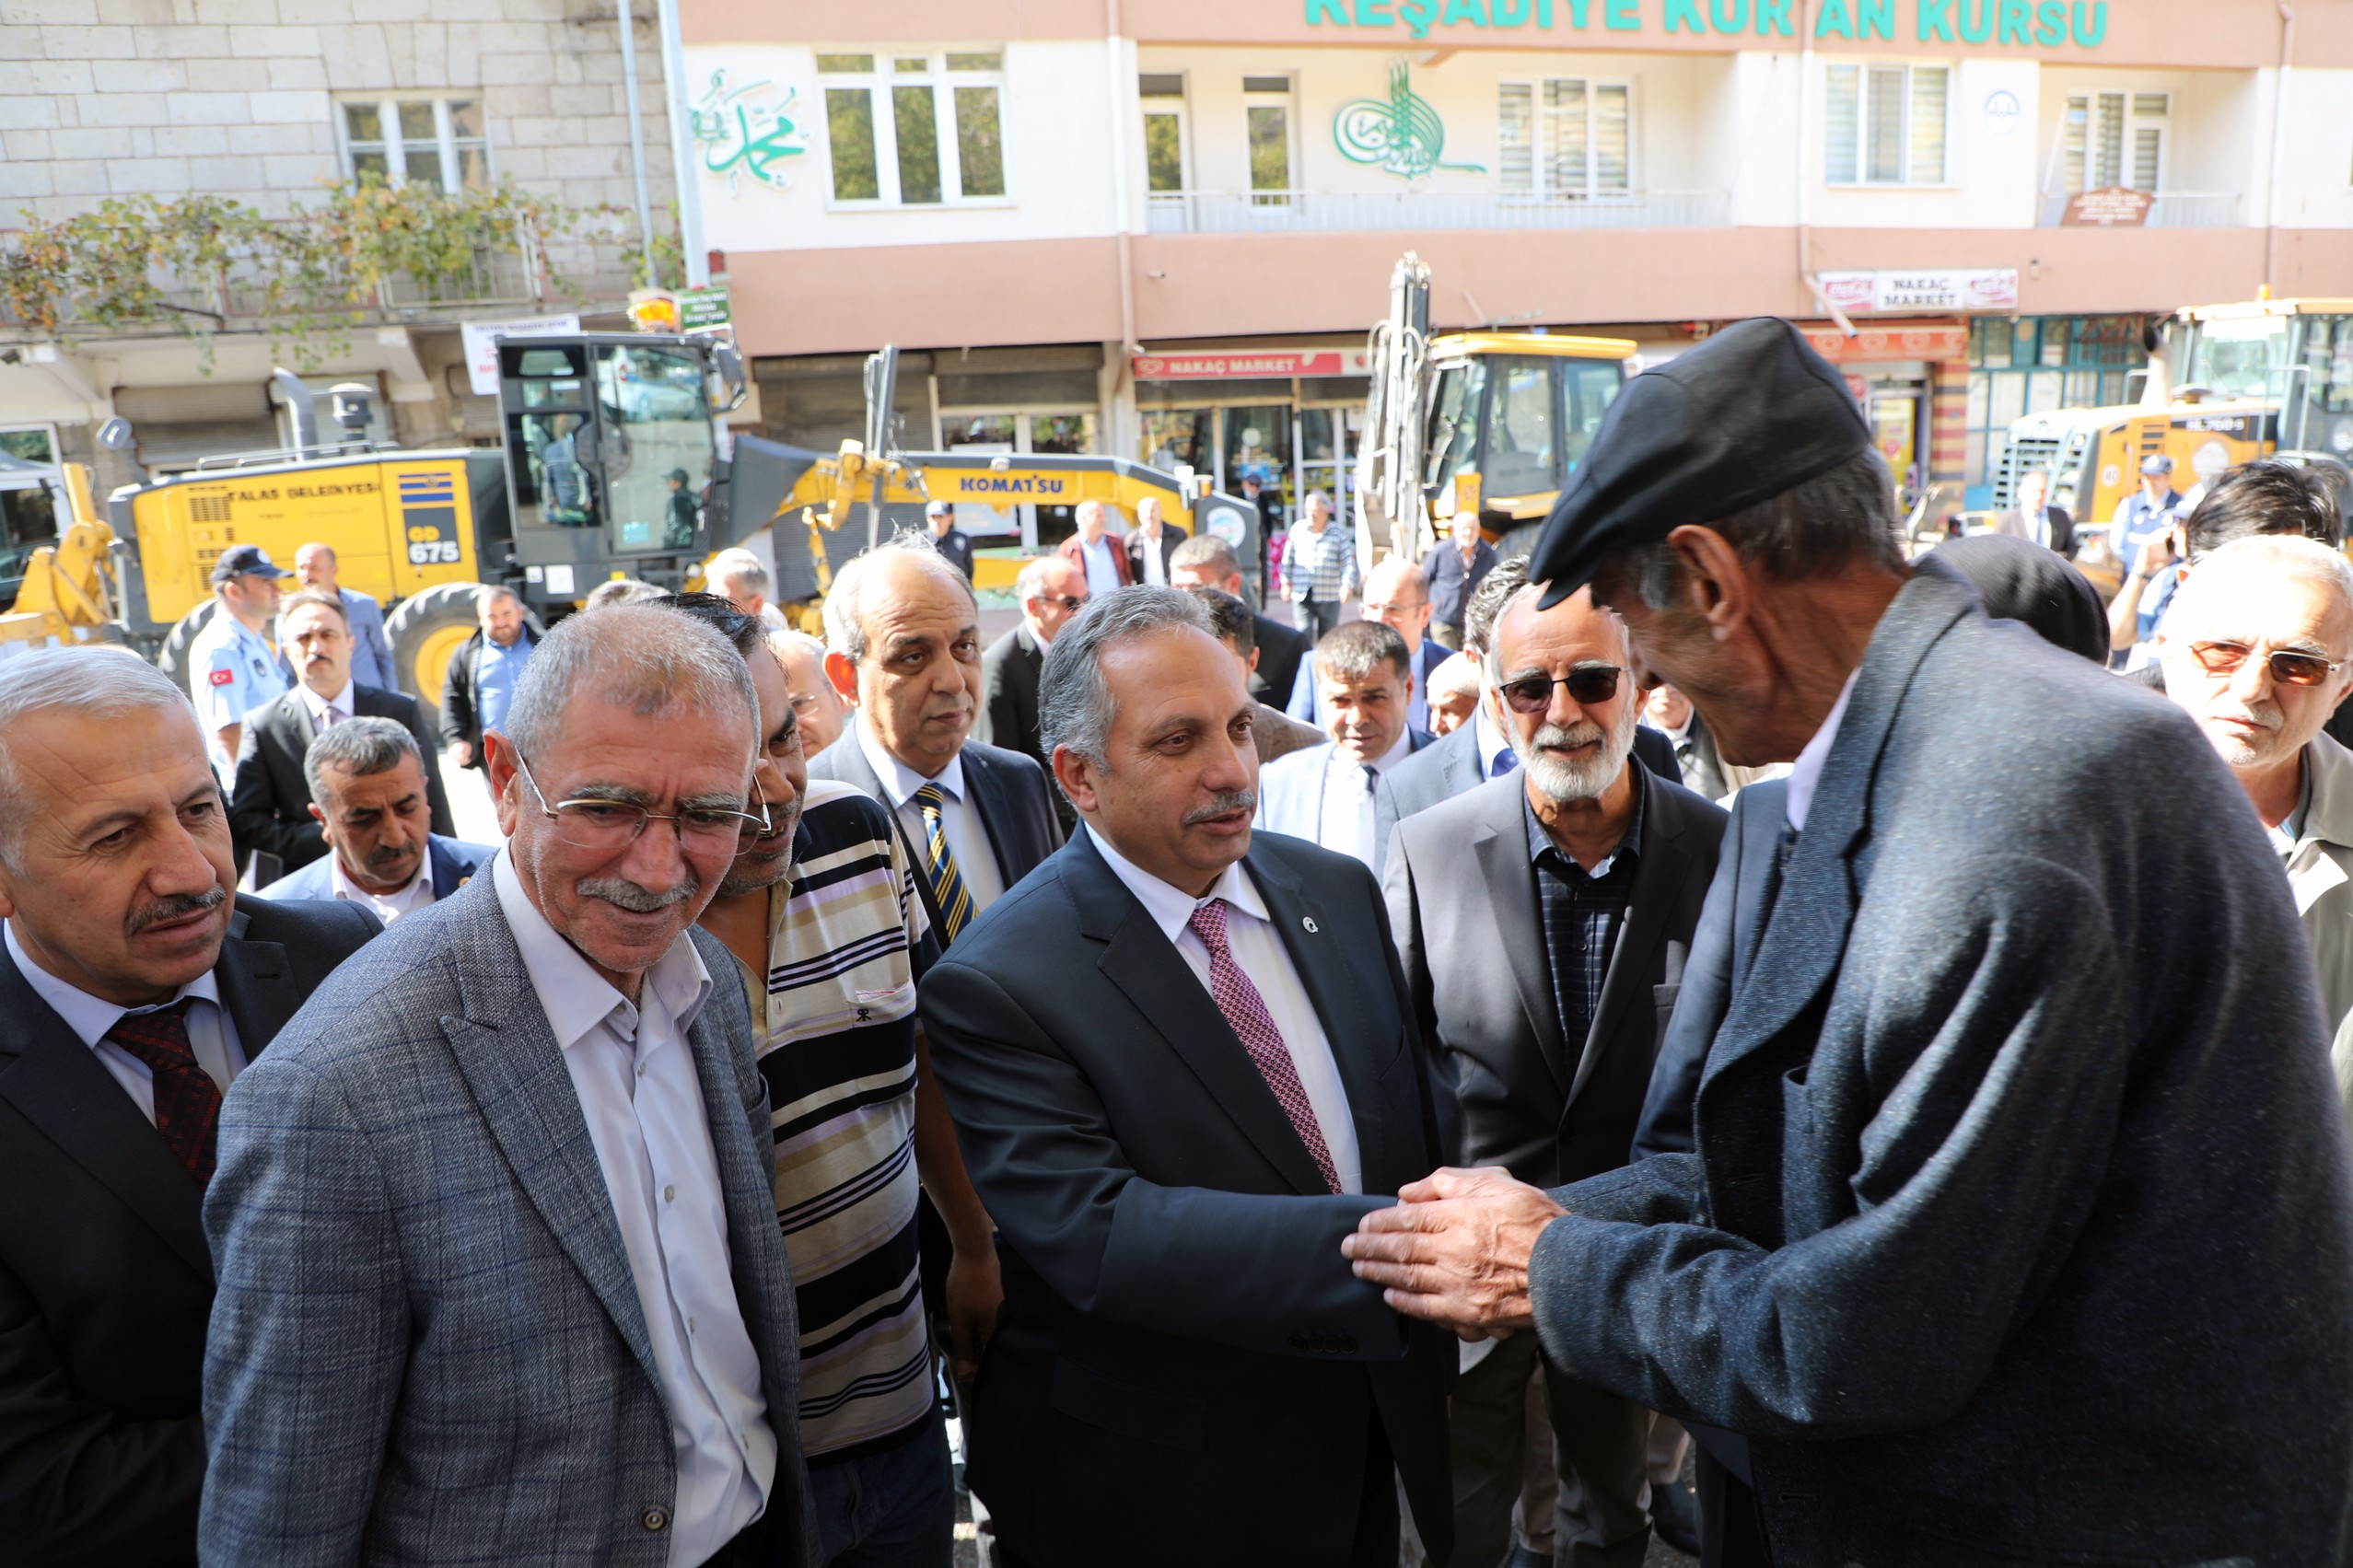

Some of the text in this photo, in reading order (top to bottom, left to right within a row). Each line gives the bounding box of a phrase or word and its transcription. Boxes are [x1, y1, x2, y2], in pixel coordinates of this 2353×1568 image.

[1916, 0, 2108, 47] KURSU
[1169, 358, 1297, 376] NAKAÇ MARKET
[961, 476, 1063, 494] KOMATSU
[227, 488, 280, 503] TALAS
[408, 526, 440, 542] GD
[409, 541, 460, 563] 675
